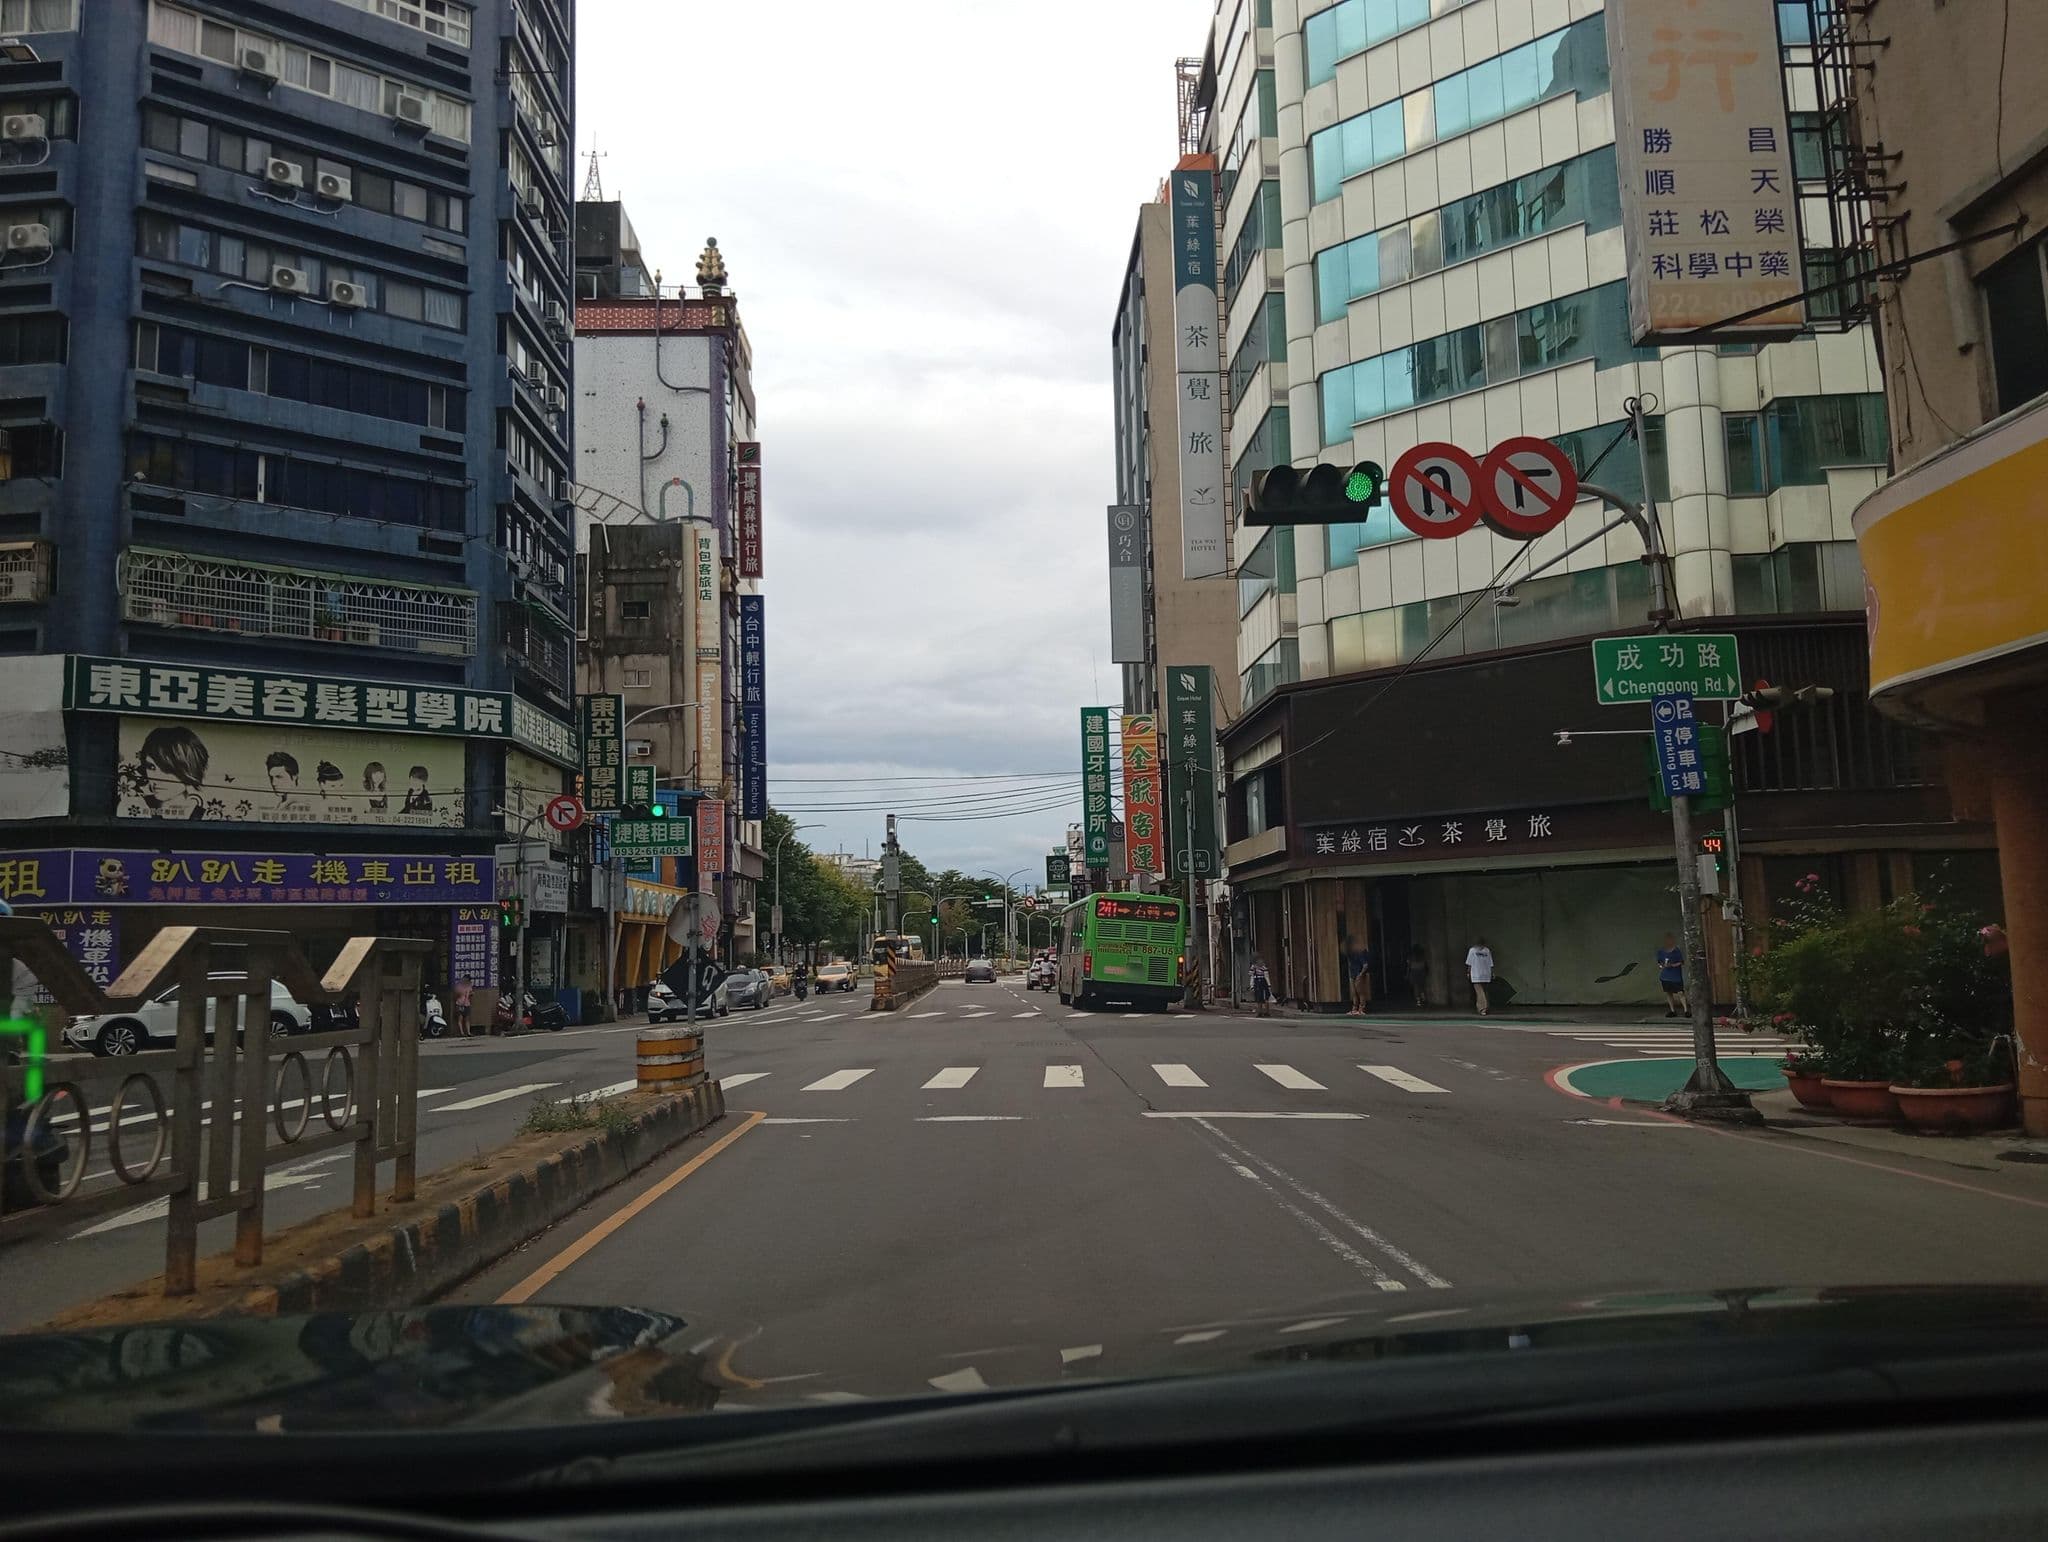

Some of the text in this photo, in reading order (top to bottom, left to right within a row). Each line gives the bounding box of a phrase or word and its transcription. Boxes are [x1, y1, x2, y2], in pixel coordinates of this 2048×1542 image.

[1648, 208, 1785, 236] 莊松榮
[1652, 251, 1790, 280] 科學中藥
[1185, 325, 1213, 456] 茶覺旅
[698, 538, 712, 601] 背包客旅店
[745, 616, 761, 702] 台中輕行旅
[1617, 643, 1721, 671] 成功路
[89, 664, 504, 733] 東亞美容髮型學院
[1618, 677, 1725, 695] Chenggong Rd.
[590, 697, 616, 736] 東亞
[702, 672, 716, 751] Backpacker
[1663, 729, 1677, 771] Parking
[1674, 726, 1701, 791] 停車場
[1086, 714, 1107, 833] 建國牙醫診所
[614, 821, 687, 844] 捷隆租車
[614, 847, 687, 857] 0932-664055
[1315, 814, 1552, 855] 葉綠宿 茶覺旅
[1703, 838, 1721, 852] 44
[0, 861, 46, 898] 租
[150, 858, 288, 885] 趴趴走
[309, 860, 482, 885] 機車出租
[40, 910, 112, 925] 趴趴走
[79, 929, 112, 994] 機車出
